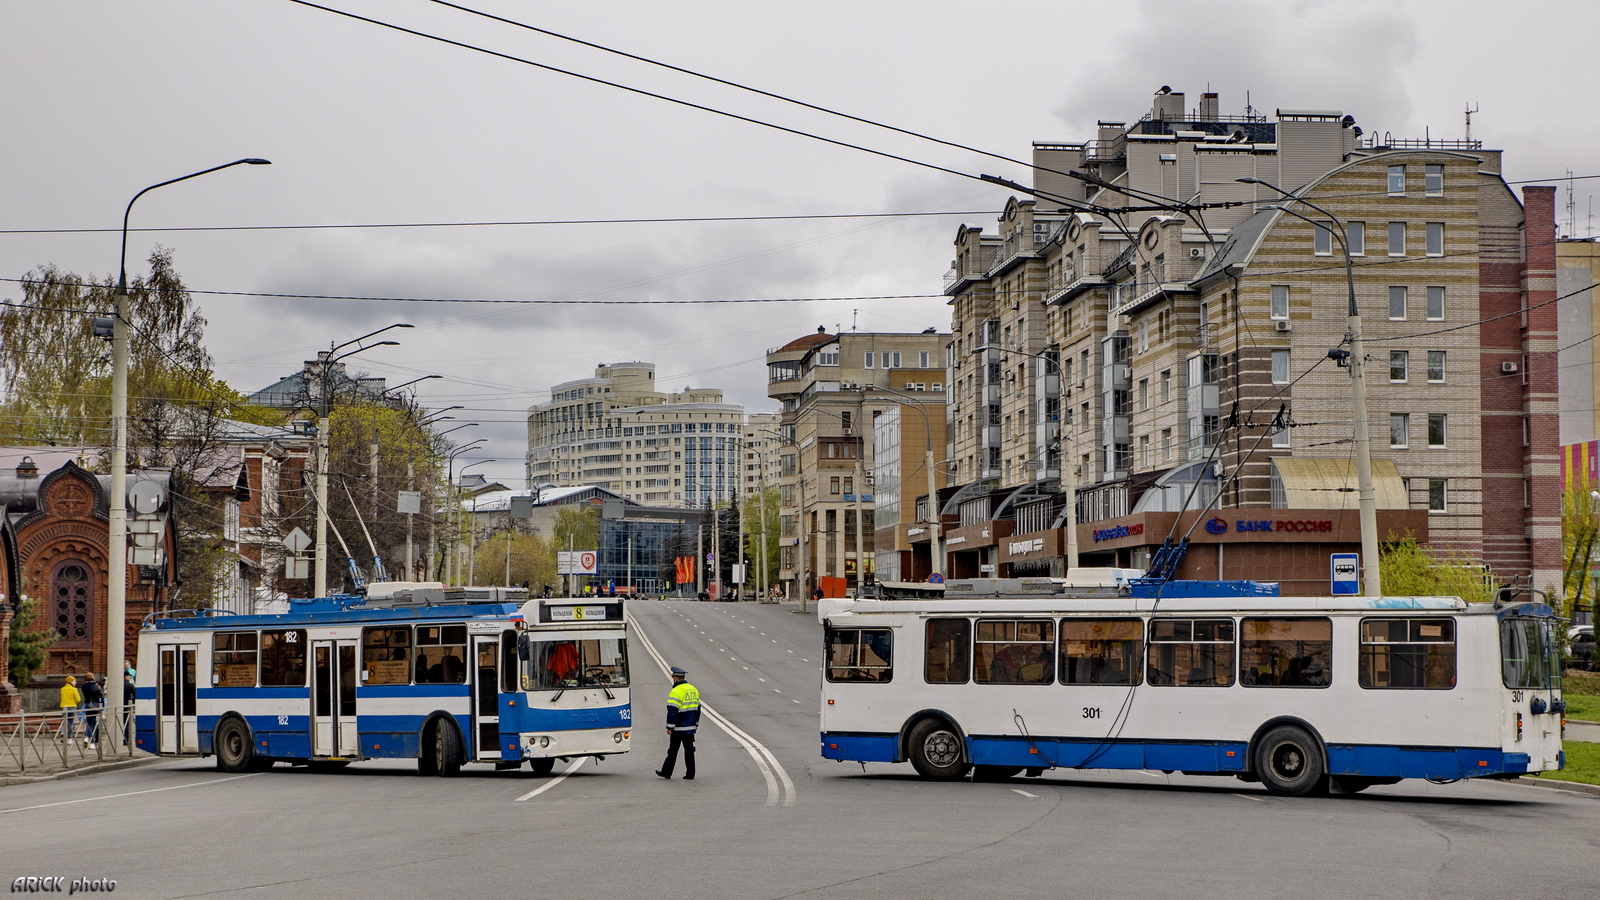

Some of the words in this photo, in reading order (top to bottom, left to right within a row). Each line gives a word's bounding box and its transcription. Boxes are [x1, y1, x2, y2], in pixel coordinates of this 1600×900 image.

[1236, 520, 1273, 532] БАНК
[1276, 520, 1333, 532] РОССИЯ
[575, 607, 583, 619] 8
[284, 631, 297, 643] 182
[220, 669, 227, 682] 8
[368, 664, 376, 678] 8
[1512, 690, 1524, 703] 301
[619, 709, 631, 720] 182
[1082, 707, 1100, 719] 301
[277, 715, 289, 725] 182
